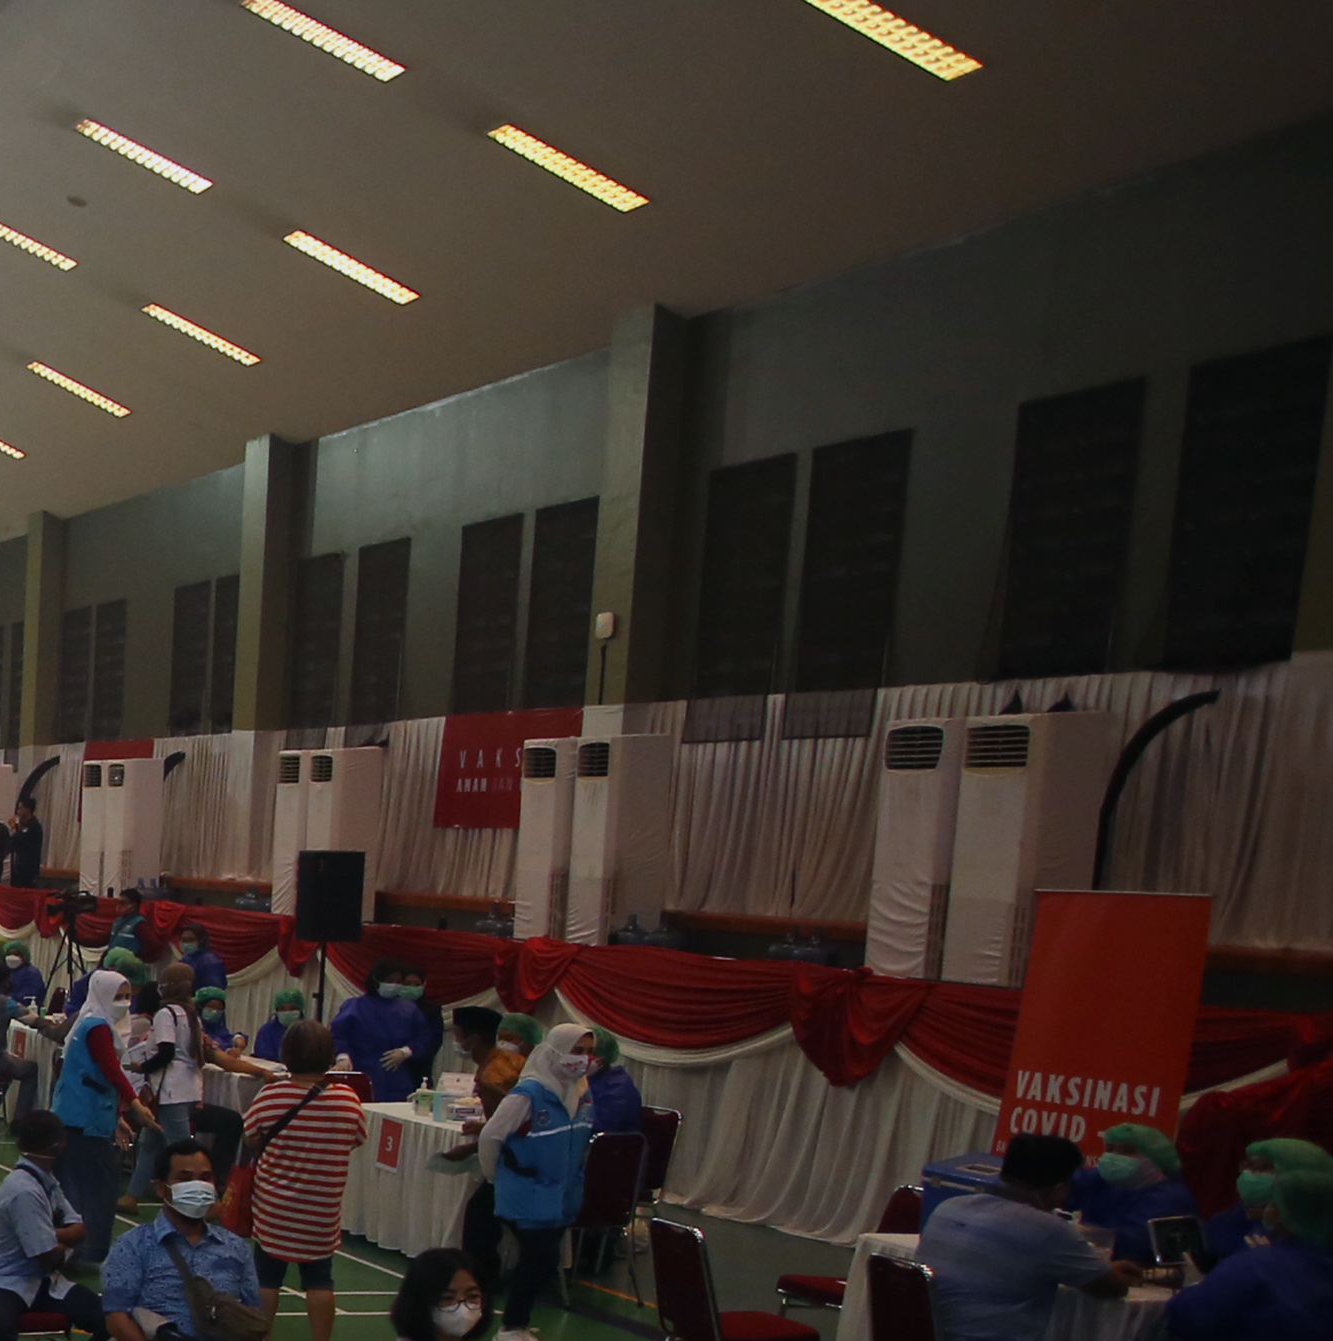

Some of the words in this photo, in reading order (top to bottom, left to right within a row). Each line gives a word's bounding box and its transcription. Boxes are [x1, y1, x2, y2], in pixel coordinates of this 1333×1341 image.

[1015, 1069, 1161, 1118] VAKSINASI
[1009, 1106, 1087, 1143] COVID
[385, 1135, 394, 1152] 3
